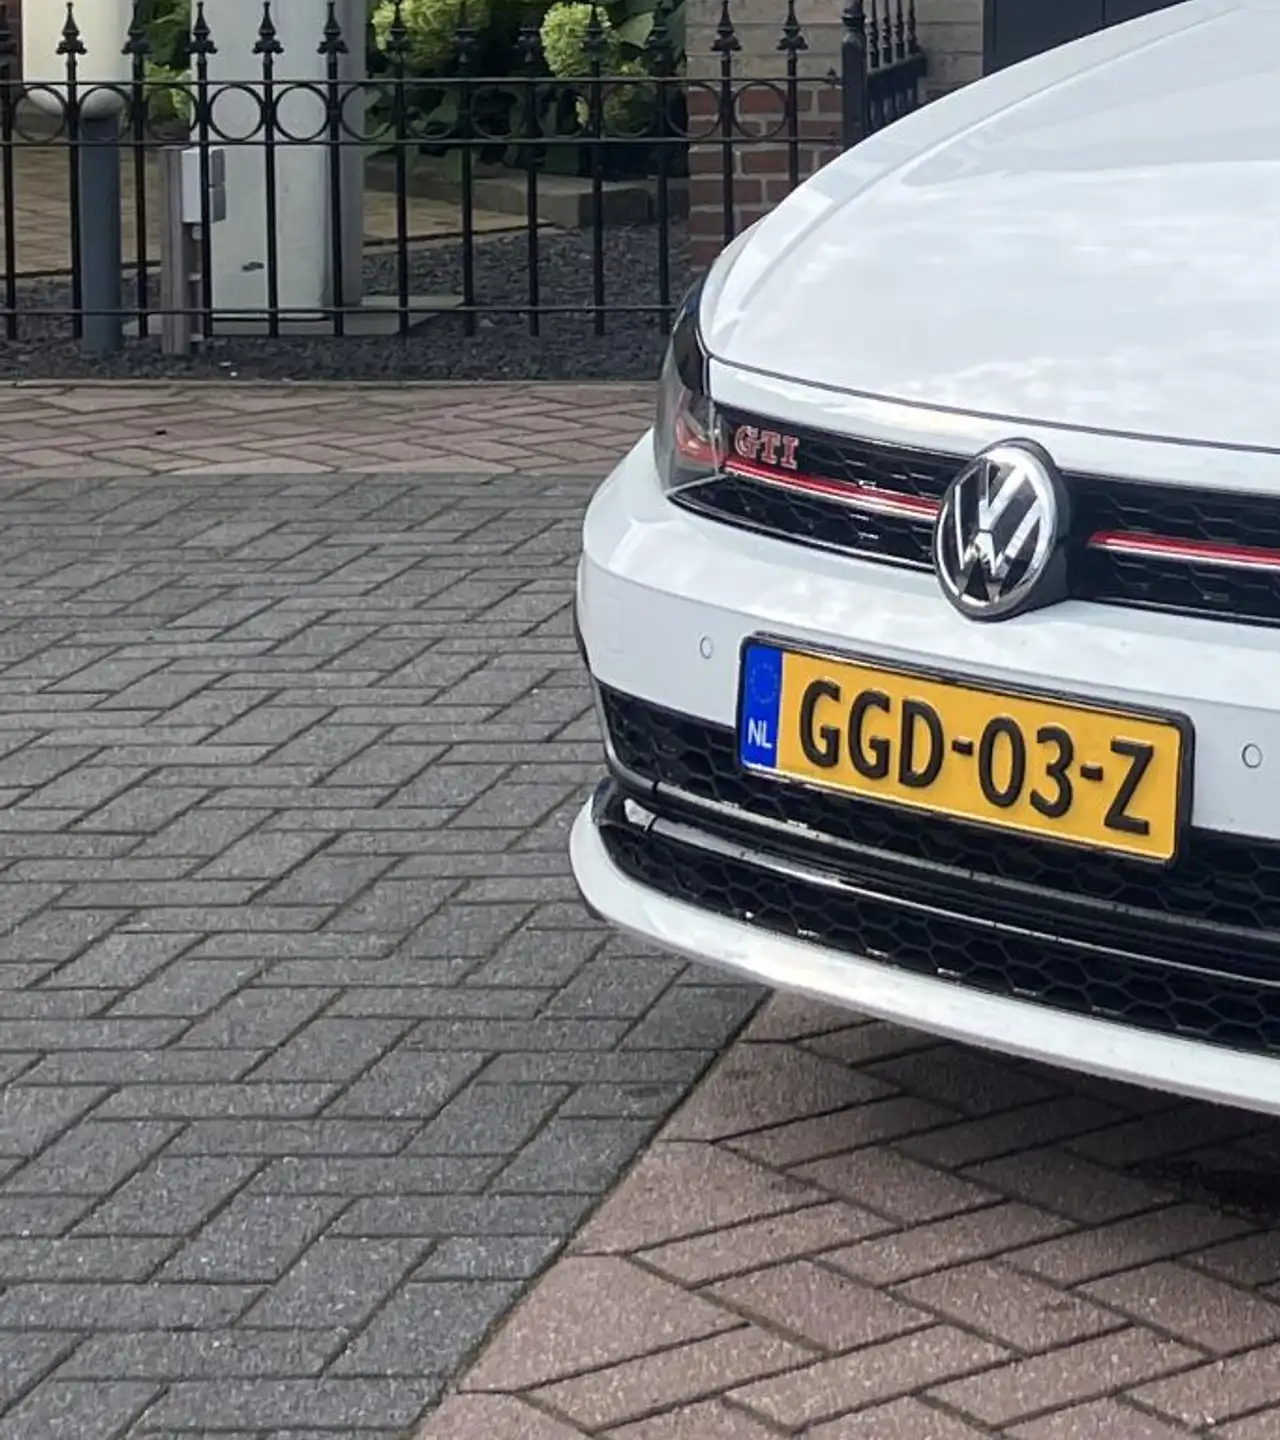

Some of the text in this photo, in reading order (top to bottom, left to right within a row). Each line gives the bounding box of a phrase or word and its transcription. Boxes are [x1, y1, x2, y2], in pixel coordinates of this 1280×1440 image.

[733, 425, 799, 471] GTI
[747, 718, 773, 750] NL
[799, 677, 1155, 836] GGD-03-Z
